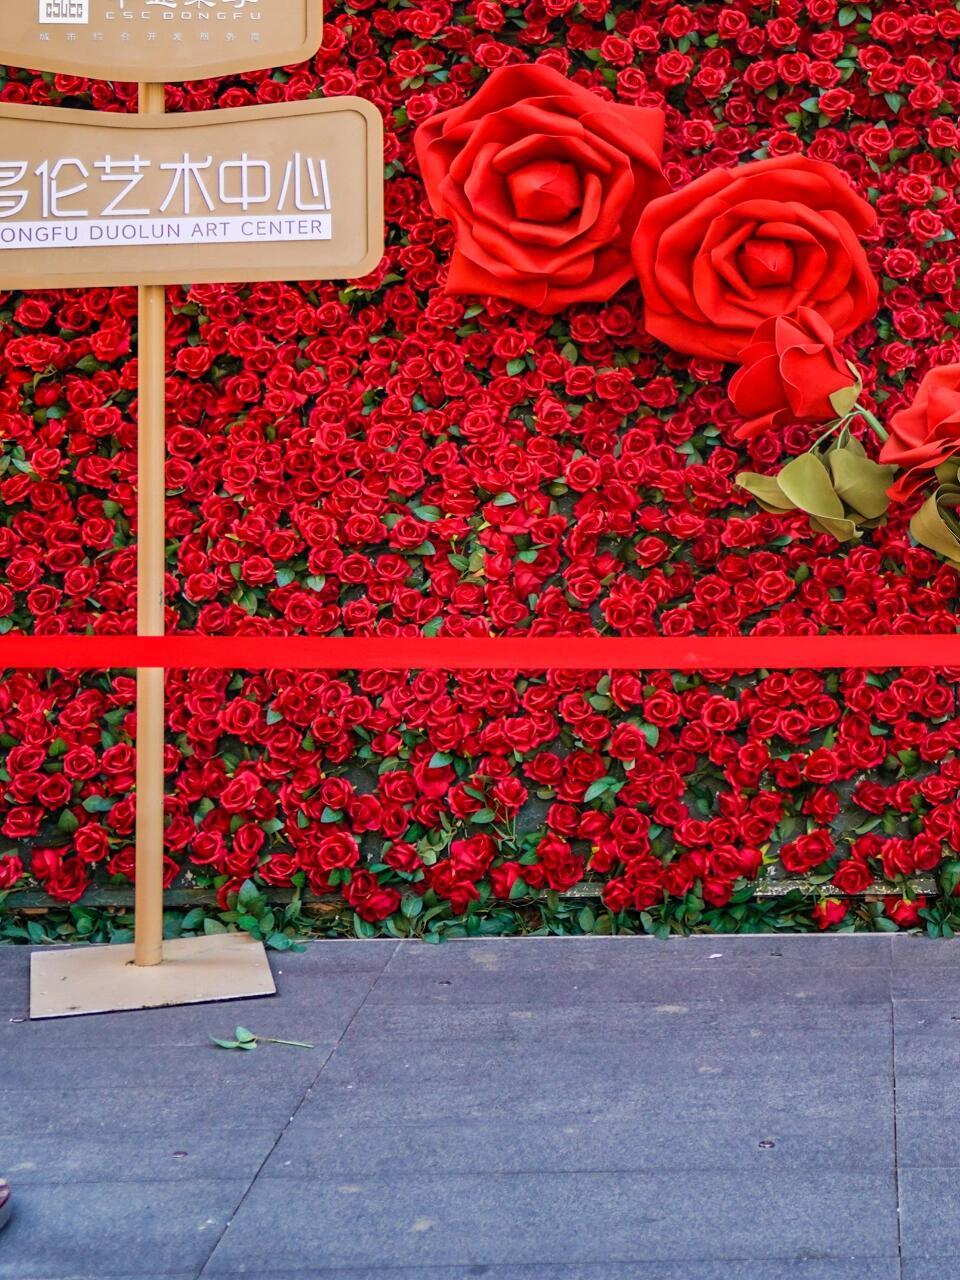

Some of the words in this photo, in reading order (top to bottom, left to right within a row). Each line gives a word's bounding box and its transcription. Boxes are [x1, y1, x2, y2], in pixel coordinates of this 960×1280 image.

[105, 11, 151, 20] CSC
[163, 11, 261, 20] DONGFU
[0, 226, 78, 243] ONGFU
[90, 223, 180, 240] DUOLUN
[191, 222, 230, 237] ART
[241, 219, 322, 236] CENTER
